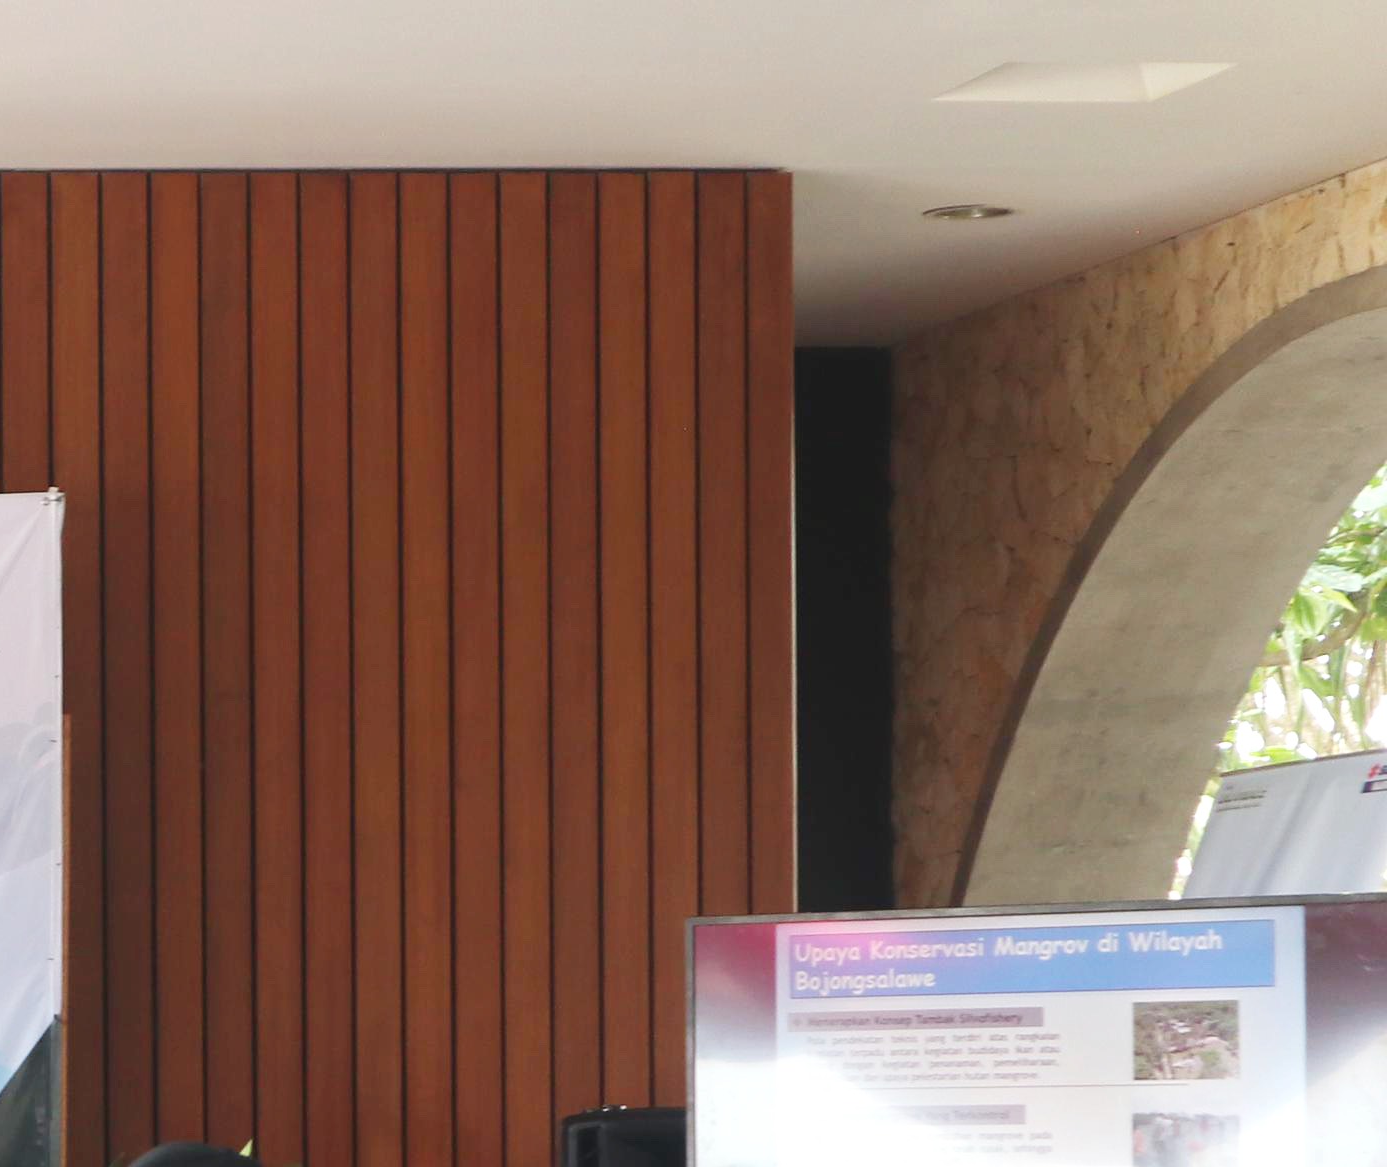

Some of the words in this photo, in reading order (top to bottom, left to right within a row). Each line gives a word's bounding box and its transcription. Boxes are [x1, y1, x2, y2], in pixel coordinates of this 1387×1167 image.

[794, 942, 861, 966] Upaya
[870, 937, 985, 962] Konservasi
[993, 935, 1088, 961] Mangrov
[1096, 933, 1118, 954] di
[1128, 929, 1224, 957] Wilayah
[794, 970, 937, 997] Bojongsalawe
